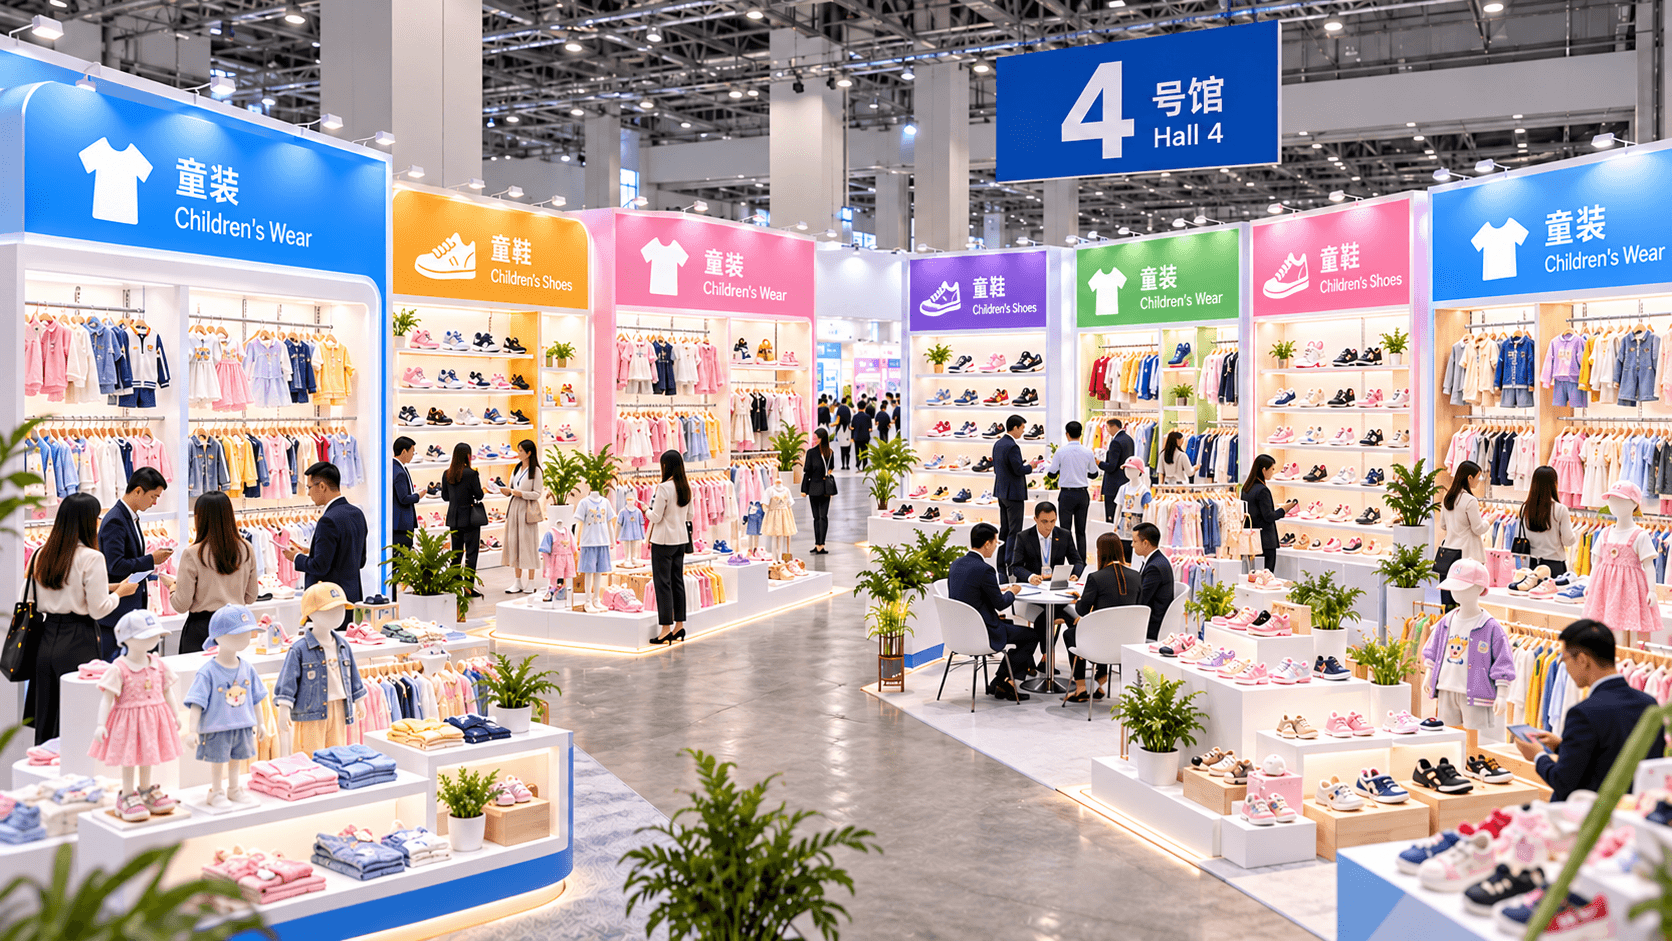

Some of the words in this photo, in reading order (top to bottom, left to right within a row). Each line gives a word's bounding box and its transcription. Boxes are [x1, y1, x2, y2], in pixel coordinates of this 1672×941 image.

[1061, 60, 1135, 159] 4
[1152, 75, 1224, 117] 号馆
[1154, 123, 1199, 148] Hall
[1207, 122, 1224, 144] 4
[175, 157, 239, 206] 童装
[174, 206, 265, 241] Children's
[268, 220, 313, 248] Wear
[1545, 203, 1606, 247] 童装
[490, 233, 532, 266] 童鞋
[703, 248, 744, 278] 童装
[1319, 241, 1360, 274] 童鞋
[1544, 247, 1620, 273] Children's
[1622, 244, 1666, 265] Wear
[490, 268, 541, 288] Children's
[542, 274, 573, 292] Shoes
[702, 280, 757, 299] Children's
[759, 285, 788, 302] Wear
[972, 275, 1006, 299] 童鞋
[1139, 263, 1178, 291] 童装
[1319, 276, 1368, 294] Children's
[1369, 273, 1403, 289] Shoes
[972, 302, 1011, 315] Children's
[1012, 301, 1038, 314] Shoes
[1139, 293, 1193, 310] Children's
[1194, 291, 1224, 305] Wear
